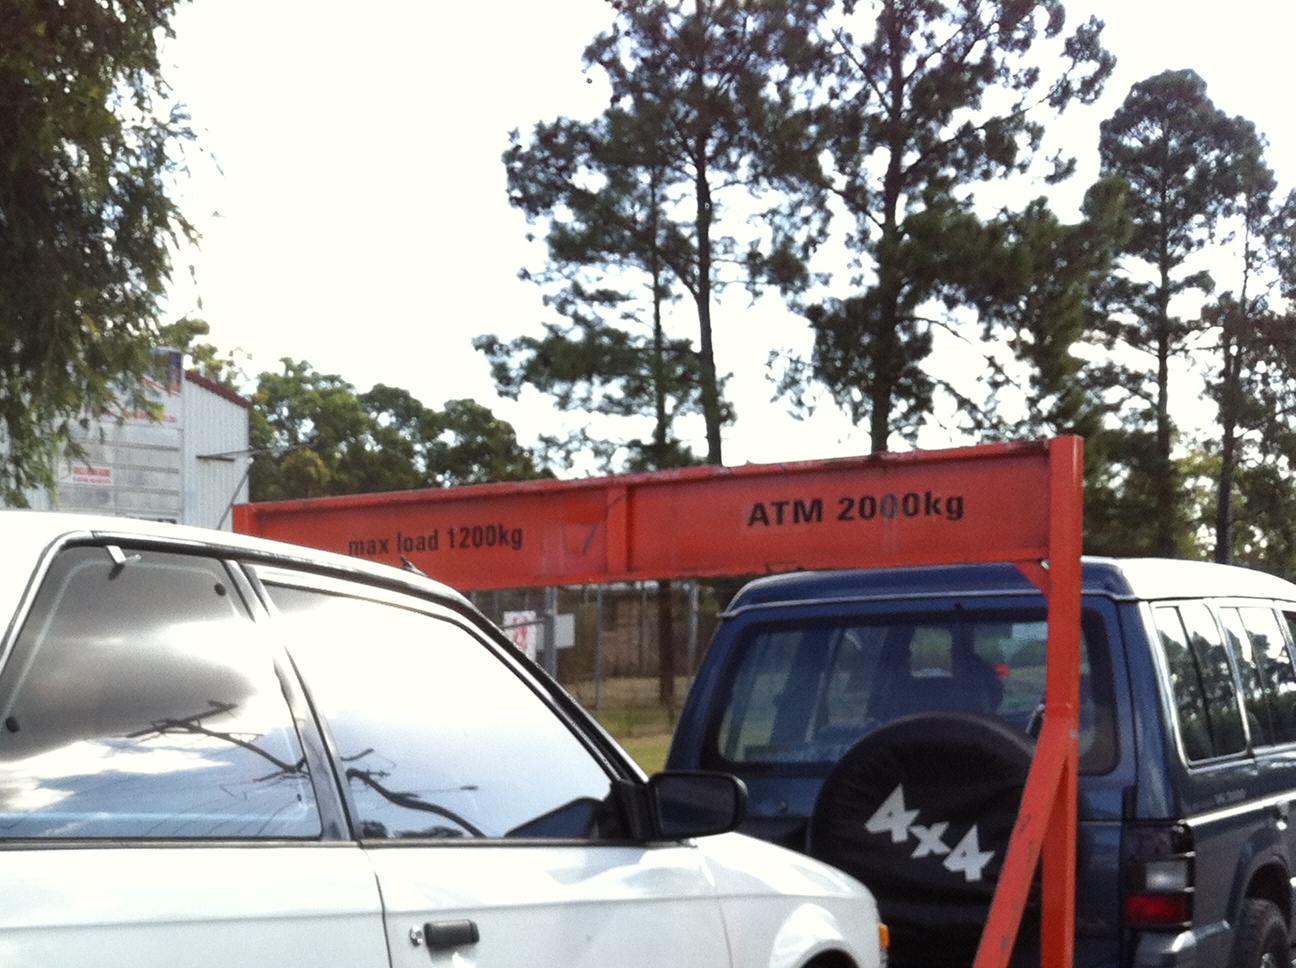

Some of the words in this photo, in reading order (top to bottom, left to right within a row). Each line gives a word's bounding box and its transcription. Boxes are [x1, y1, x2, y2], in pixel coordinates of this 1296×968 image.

[748, 498, 824, 527] ATM
[837, 491, 964, 521] 2000kg
[348, 538, 389, 556] max
[397, 529, 439, 552] load
[447, 524, 524, 551] 1200kg
[865, 782, 995, 881] 4x4
